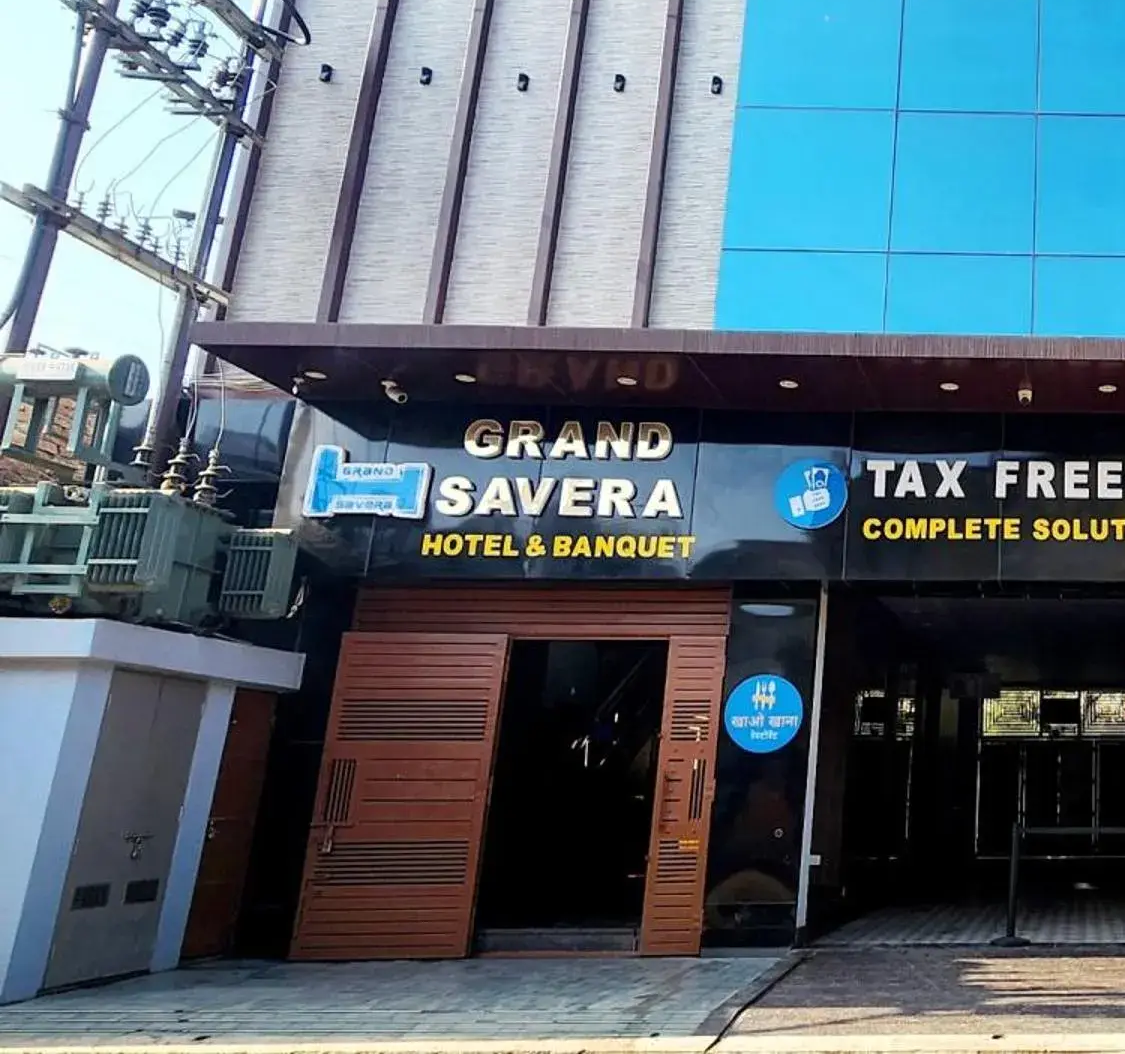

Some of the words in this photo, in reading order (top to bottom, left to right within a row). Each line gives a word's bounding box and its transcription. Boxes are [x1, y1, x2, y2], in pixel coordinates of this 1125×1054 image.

[463, 418, 675, 460] GRAND
[435, 475, 684, 519] SAVERA
[866, 459, 966, 499] TAX
[993, 460, 1125, 500] FREE
[421, 533, 518, 558] HOTEL
[525, 534, 546, 558] &
[552, 534, 697, 559] BANQUET
[862, 517, 1022, 541] COMPLETE
